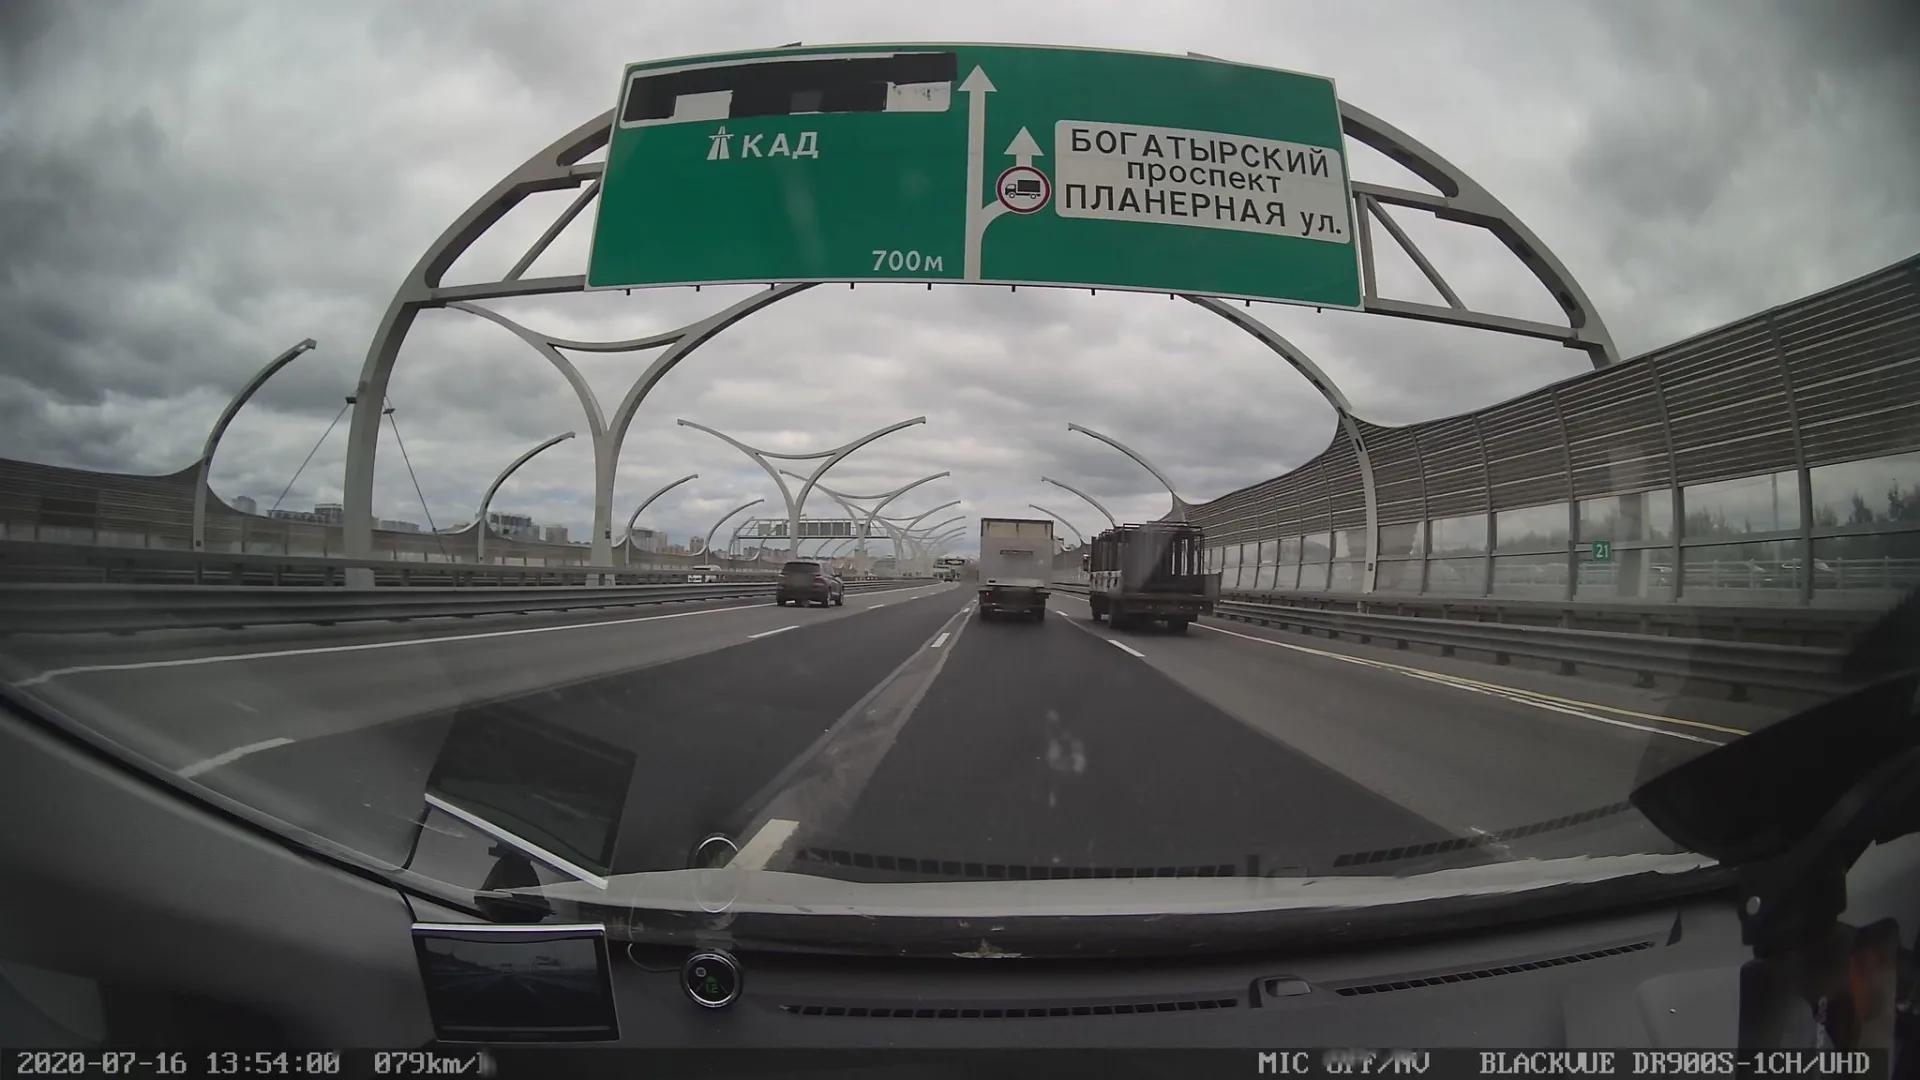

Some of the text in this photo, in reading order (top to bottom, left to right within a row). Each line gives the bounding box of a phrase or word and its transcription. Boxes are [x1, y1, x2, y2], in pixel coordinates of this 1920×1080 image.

[741, 131, 819, 160] КАД
[1071, 128, 1329, 178] БОГАТЫРСКИЙ
[1127, 161, 1281, 194] проспект
[1065, 183, 1342, 236] ПЛАНЕРНАЯ ул.
[1596, 544, 1609, 558] 21
